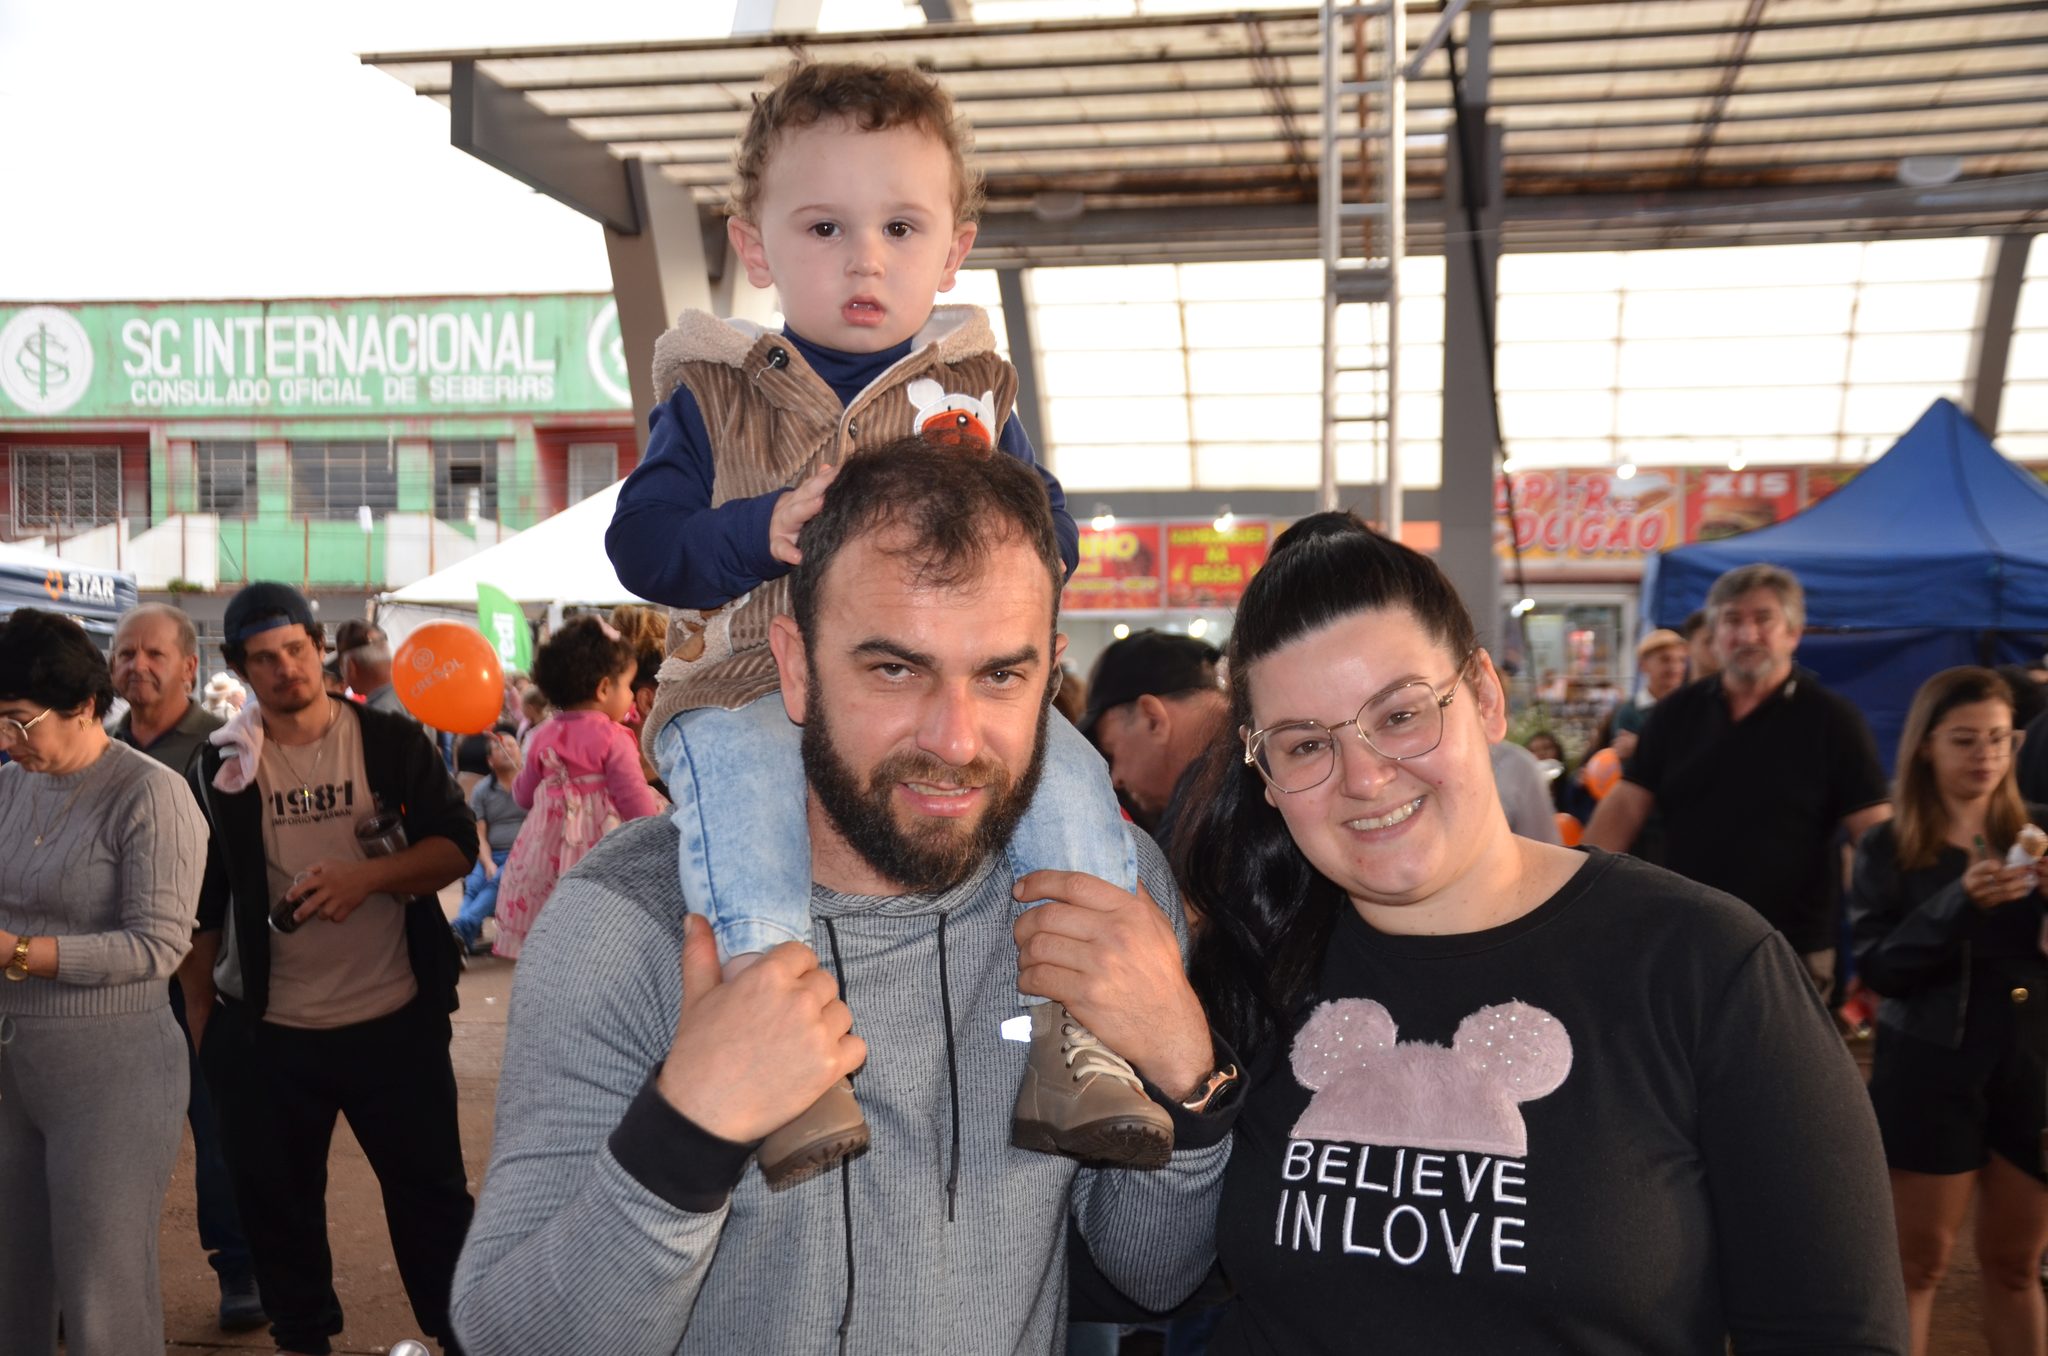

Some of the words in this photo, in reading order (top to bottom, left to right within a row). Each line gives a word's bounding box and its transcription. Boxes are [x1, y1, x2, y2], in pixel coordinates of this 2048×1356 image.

[121, 317, 182, 378] SC
[192, 311, 555, 378] INTERNACIONAL
[130, 379, 271, 407] CONSULADO
[279, 377, 371, 405] OFICIAL
[383, 377, 417, 405] DE
[1705, 473, 1790, 497] XIS
[68, 571, 115, 599] STAR
[268, 779, 353, 816] 1981
[1281, 1139, 1528, 1206] BELIEVE
[1274, 1189, 1327, 1253] IN
[1342, 1196, 1527, 1275] LOVE
